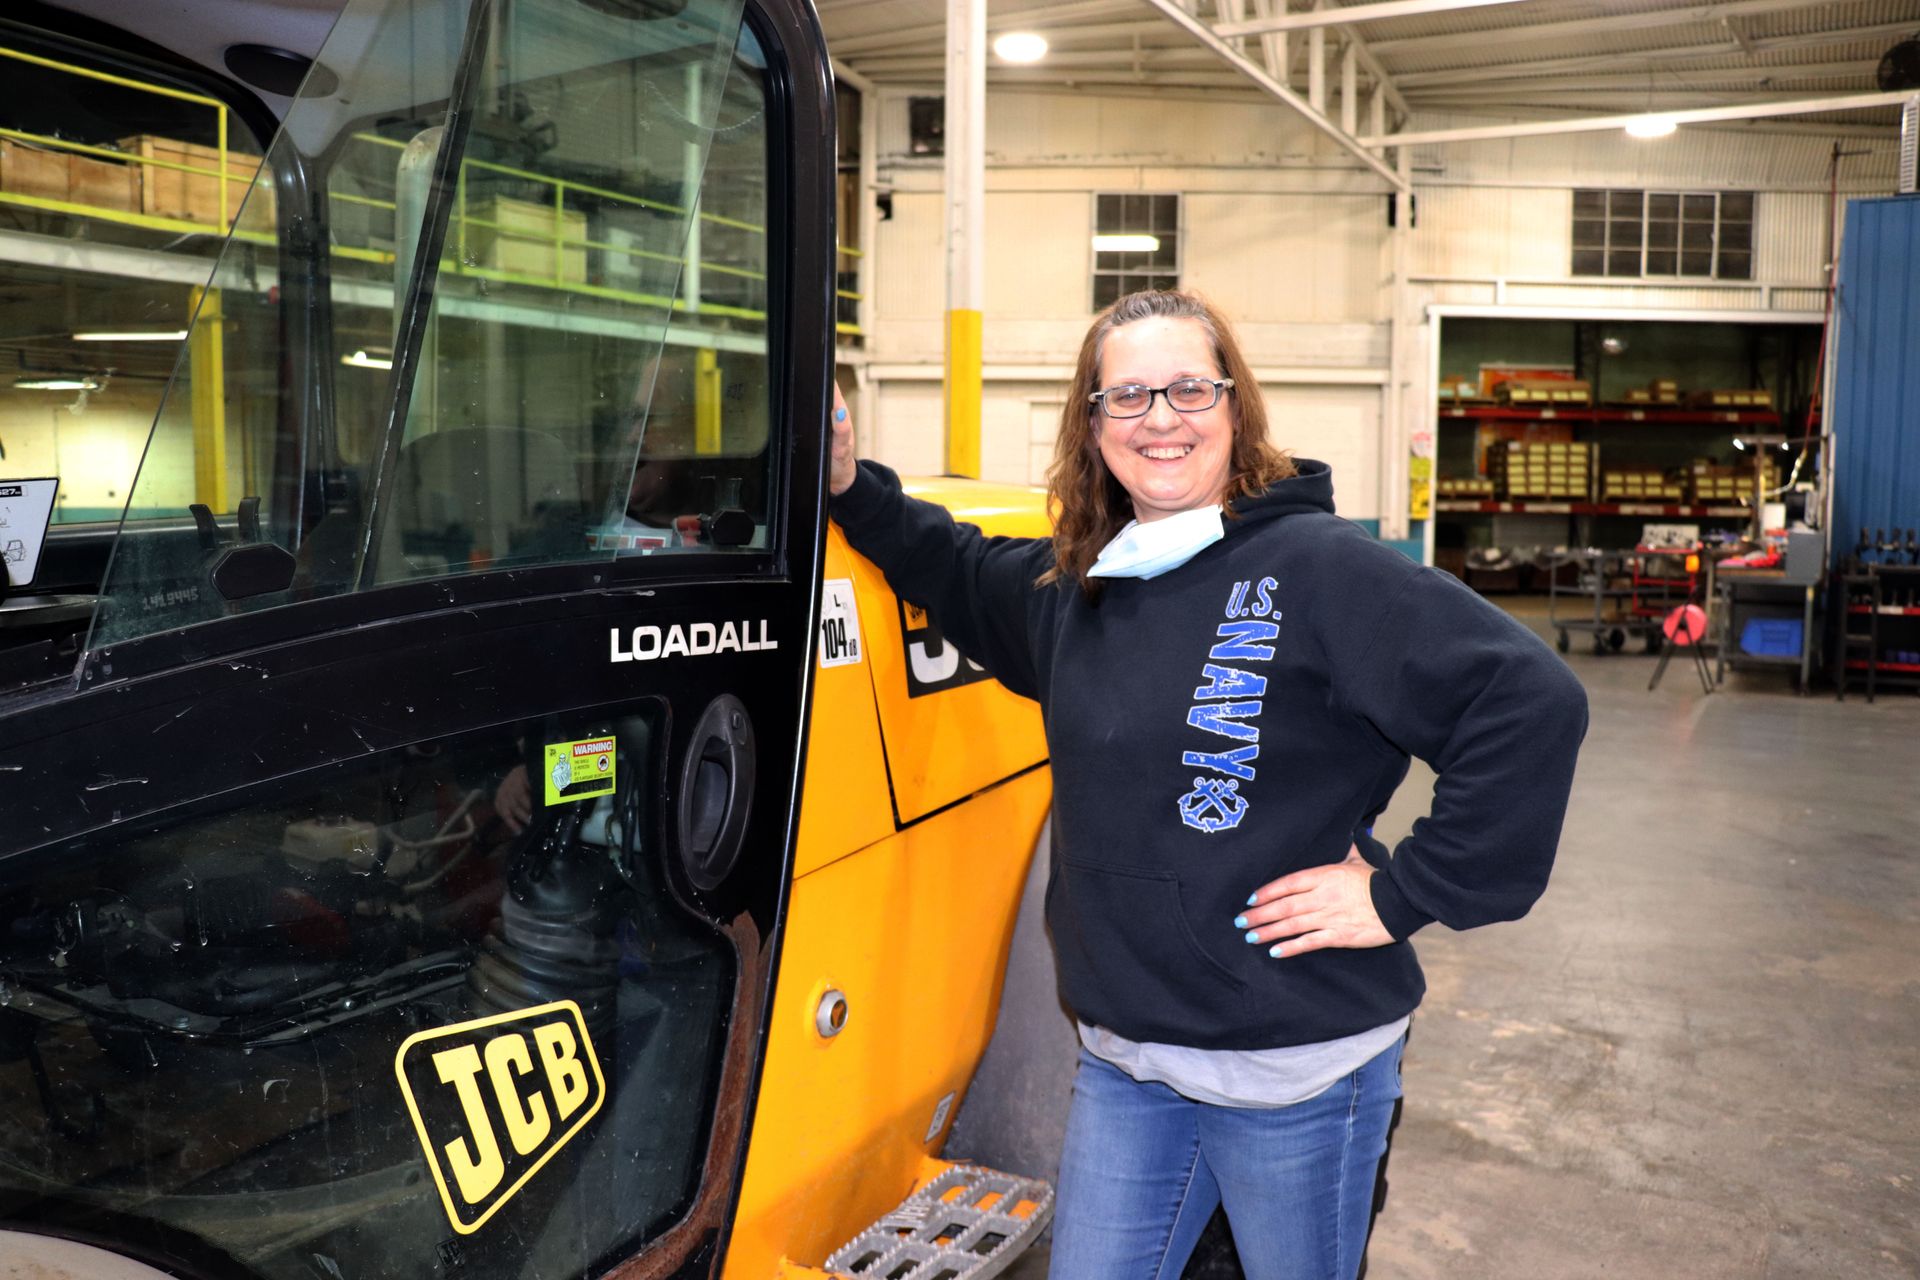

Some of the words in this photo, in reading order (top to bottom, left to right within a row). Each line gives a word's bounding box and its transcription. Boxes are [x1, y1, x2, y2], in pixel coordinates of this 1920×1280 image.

[1225, 576, 1282, 620] U.S.
[610, 619, 778, 663] LOADALL
[822, 617, 847, 660] 104
[1182, 620, 1279, 781] NAVY
[574, 741, 612, 755] WARNING
[431, 1021, 589, 1205] JCB
